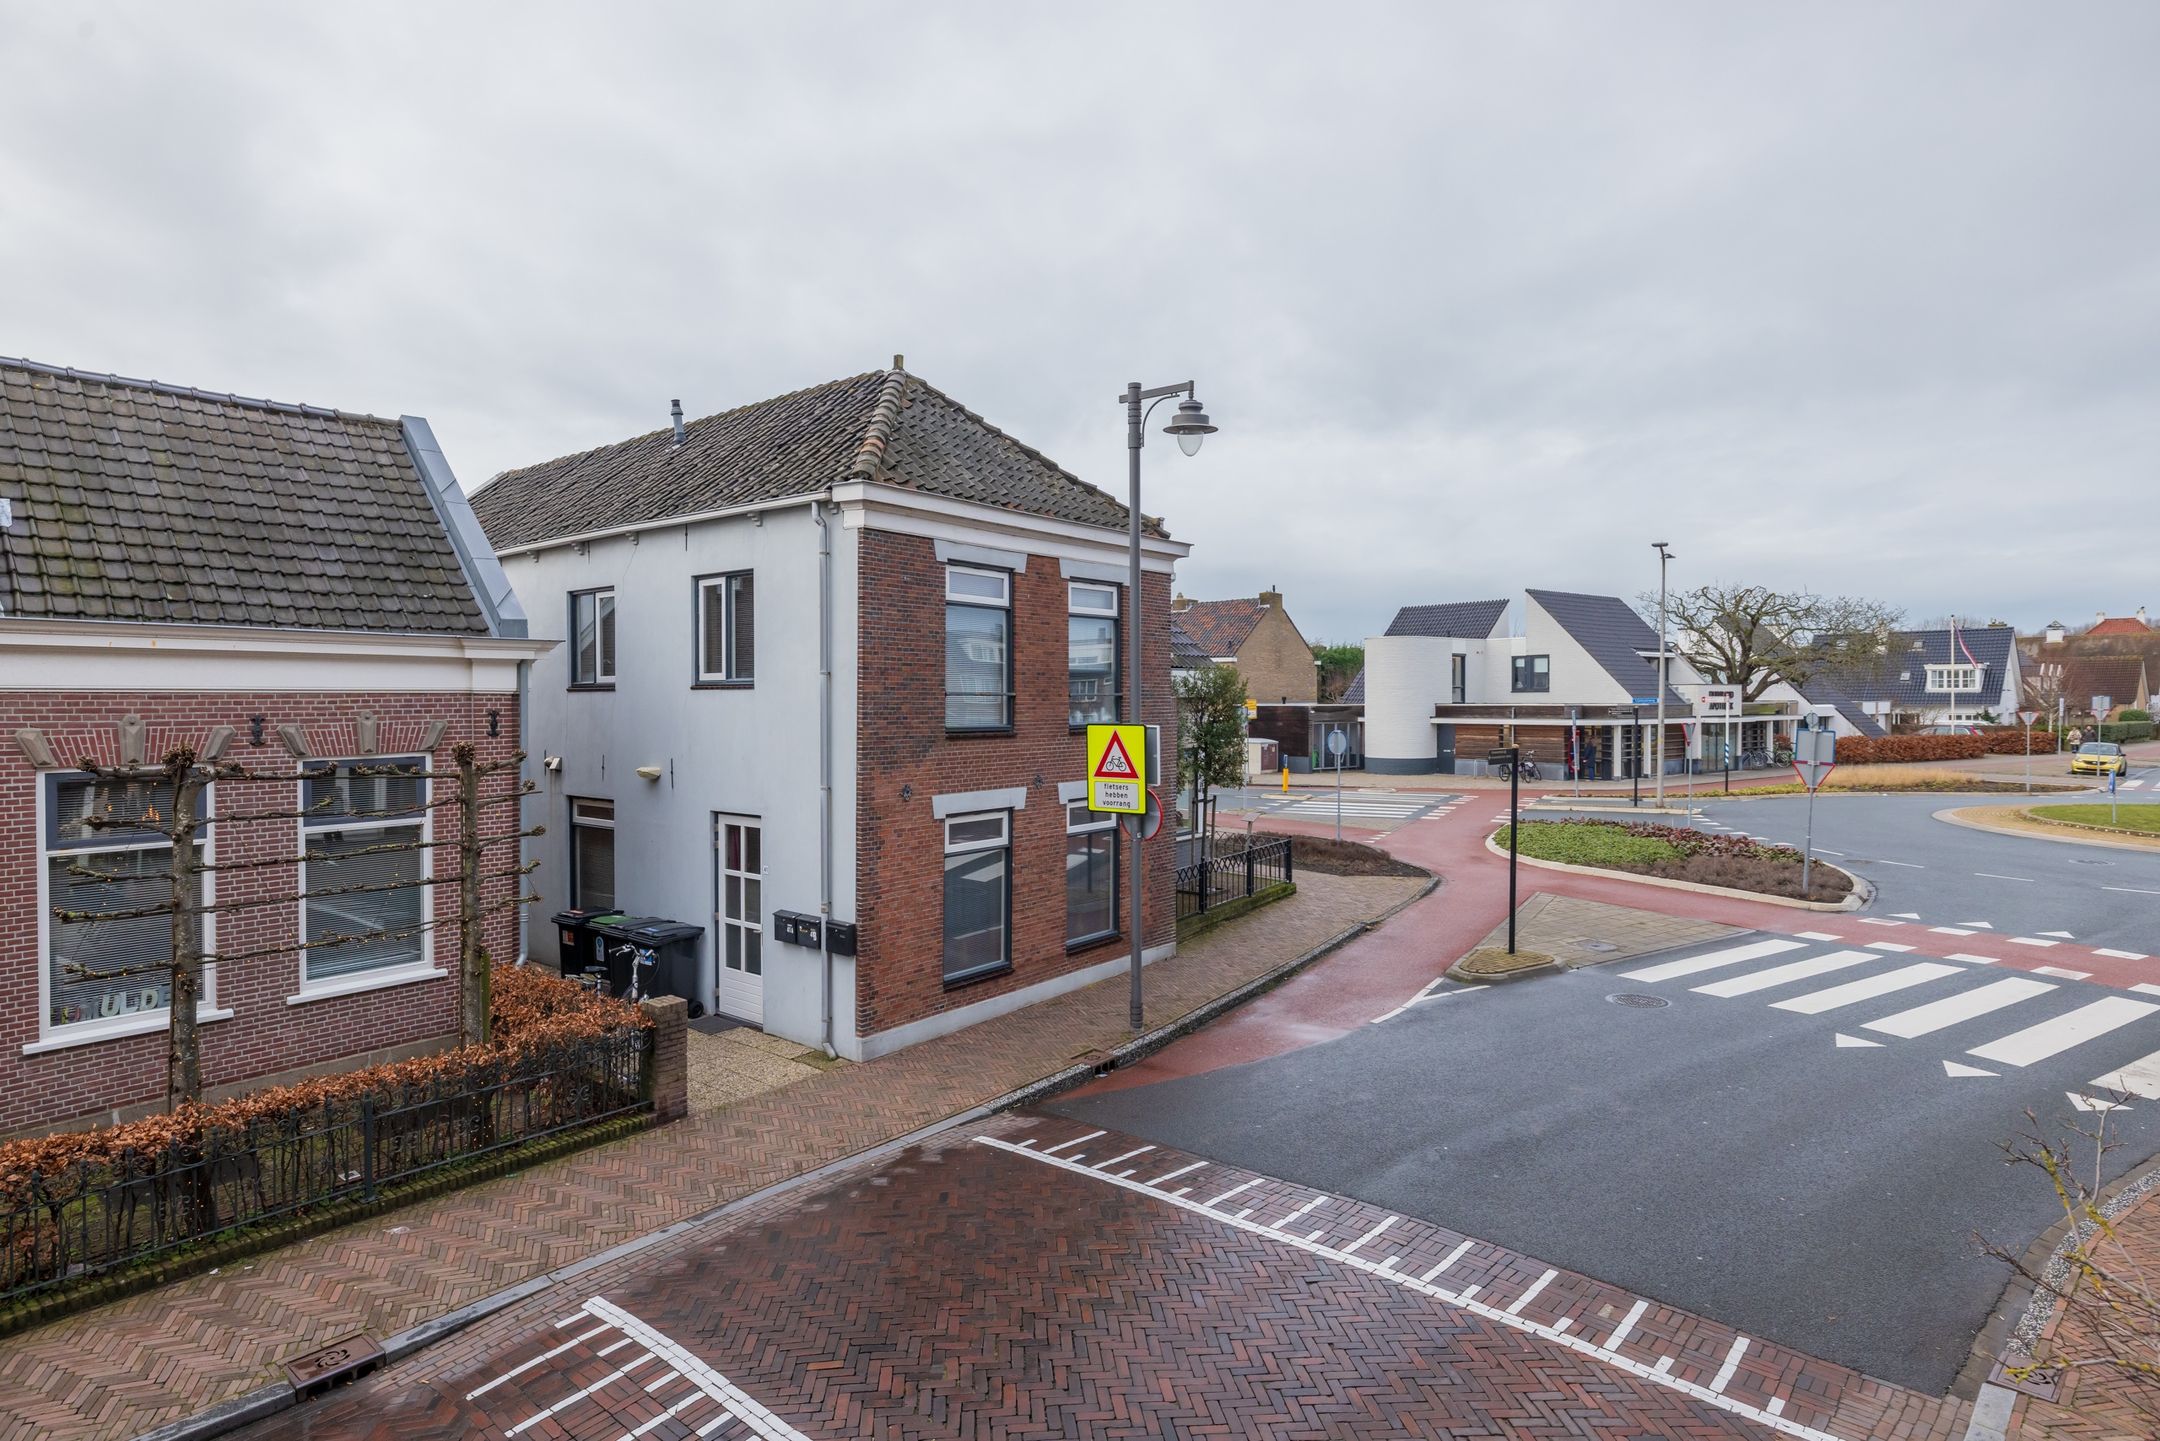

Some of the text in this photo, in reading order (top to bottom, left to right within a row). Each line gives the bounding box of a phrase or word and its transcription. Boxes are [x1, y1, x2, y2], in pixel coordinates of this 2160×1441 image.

[1104, 783, 1129, 791] fietsers
[1105, 791, 1129, 799] hebben
[1102, 800, 1131, 808] voorrang
